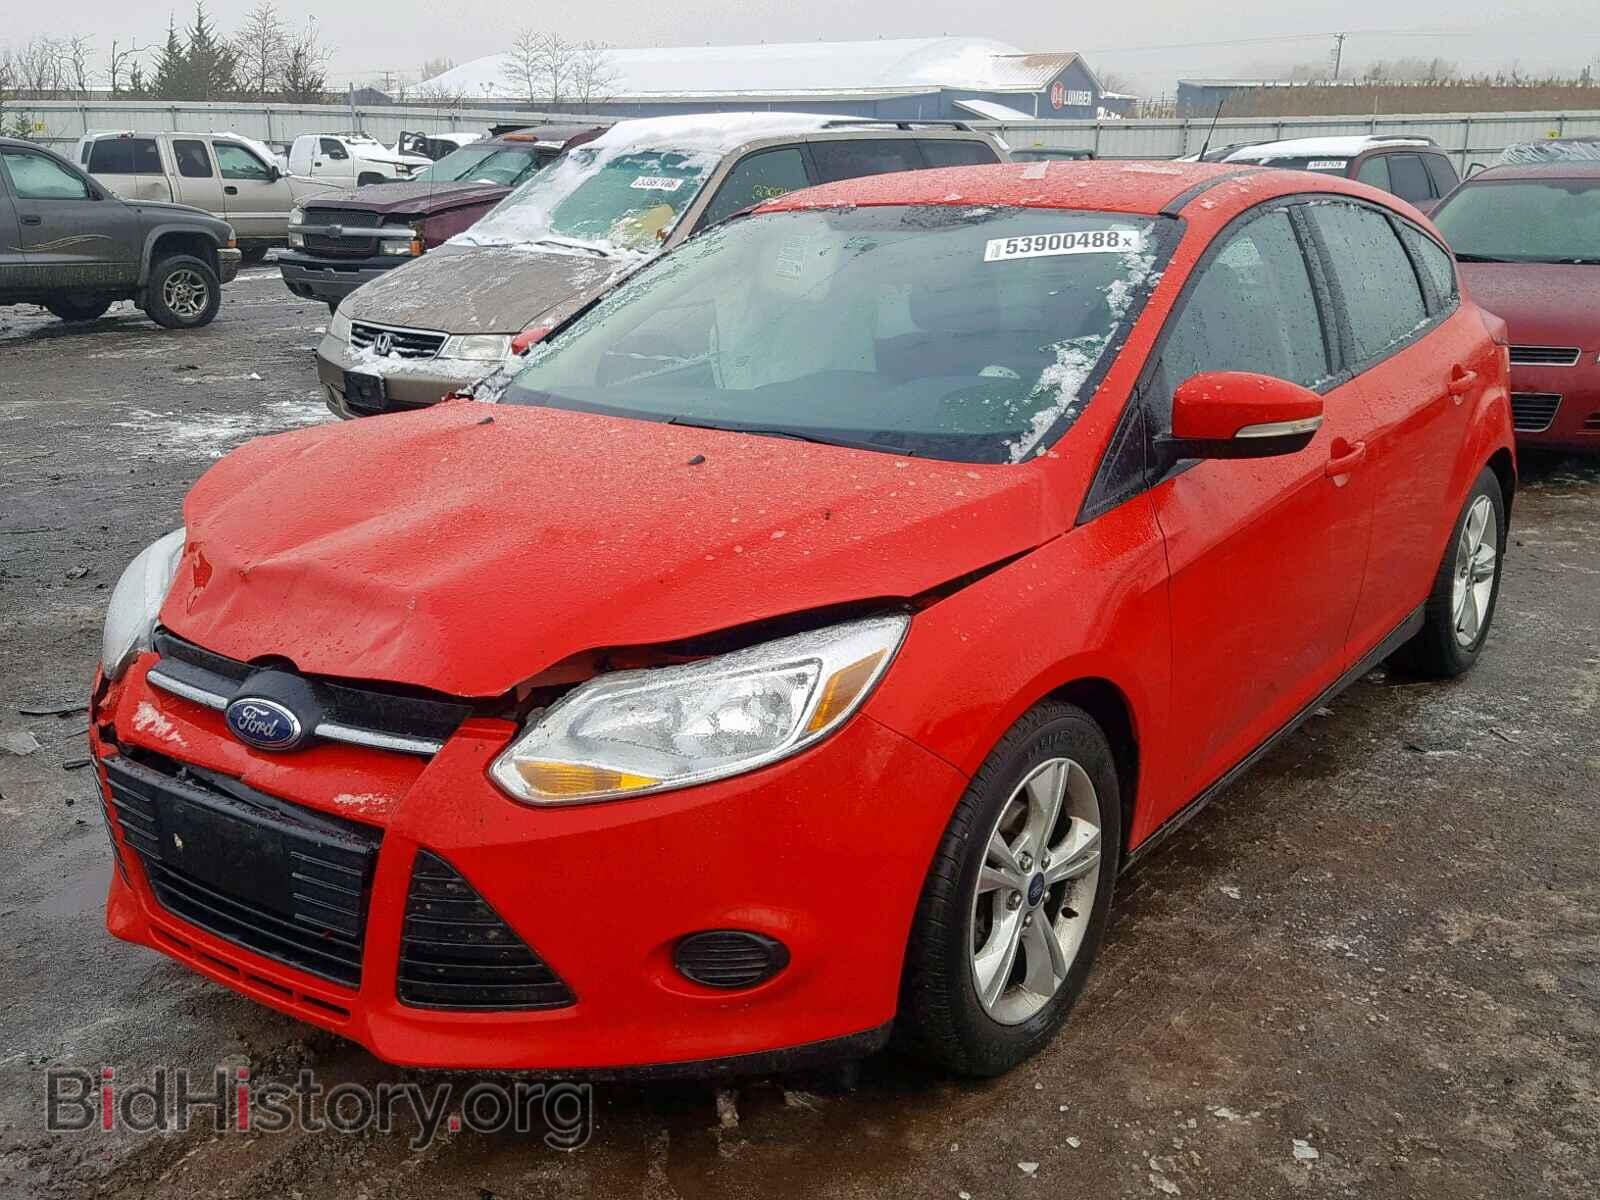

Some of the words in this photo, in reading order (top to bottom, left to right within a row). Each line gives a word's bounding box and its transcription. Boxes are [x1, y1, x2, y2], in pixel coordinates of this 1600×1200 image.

[1064, 90, 1092, 106] LUMBER
[1005, 231, 1120, 255] 53900488
[237, 705, 280, 737] Ford
